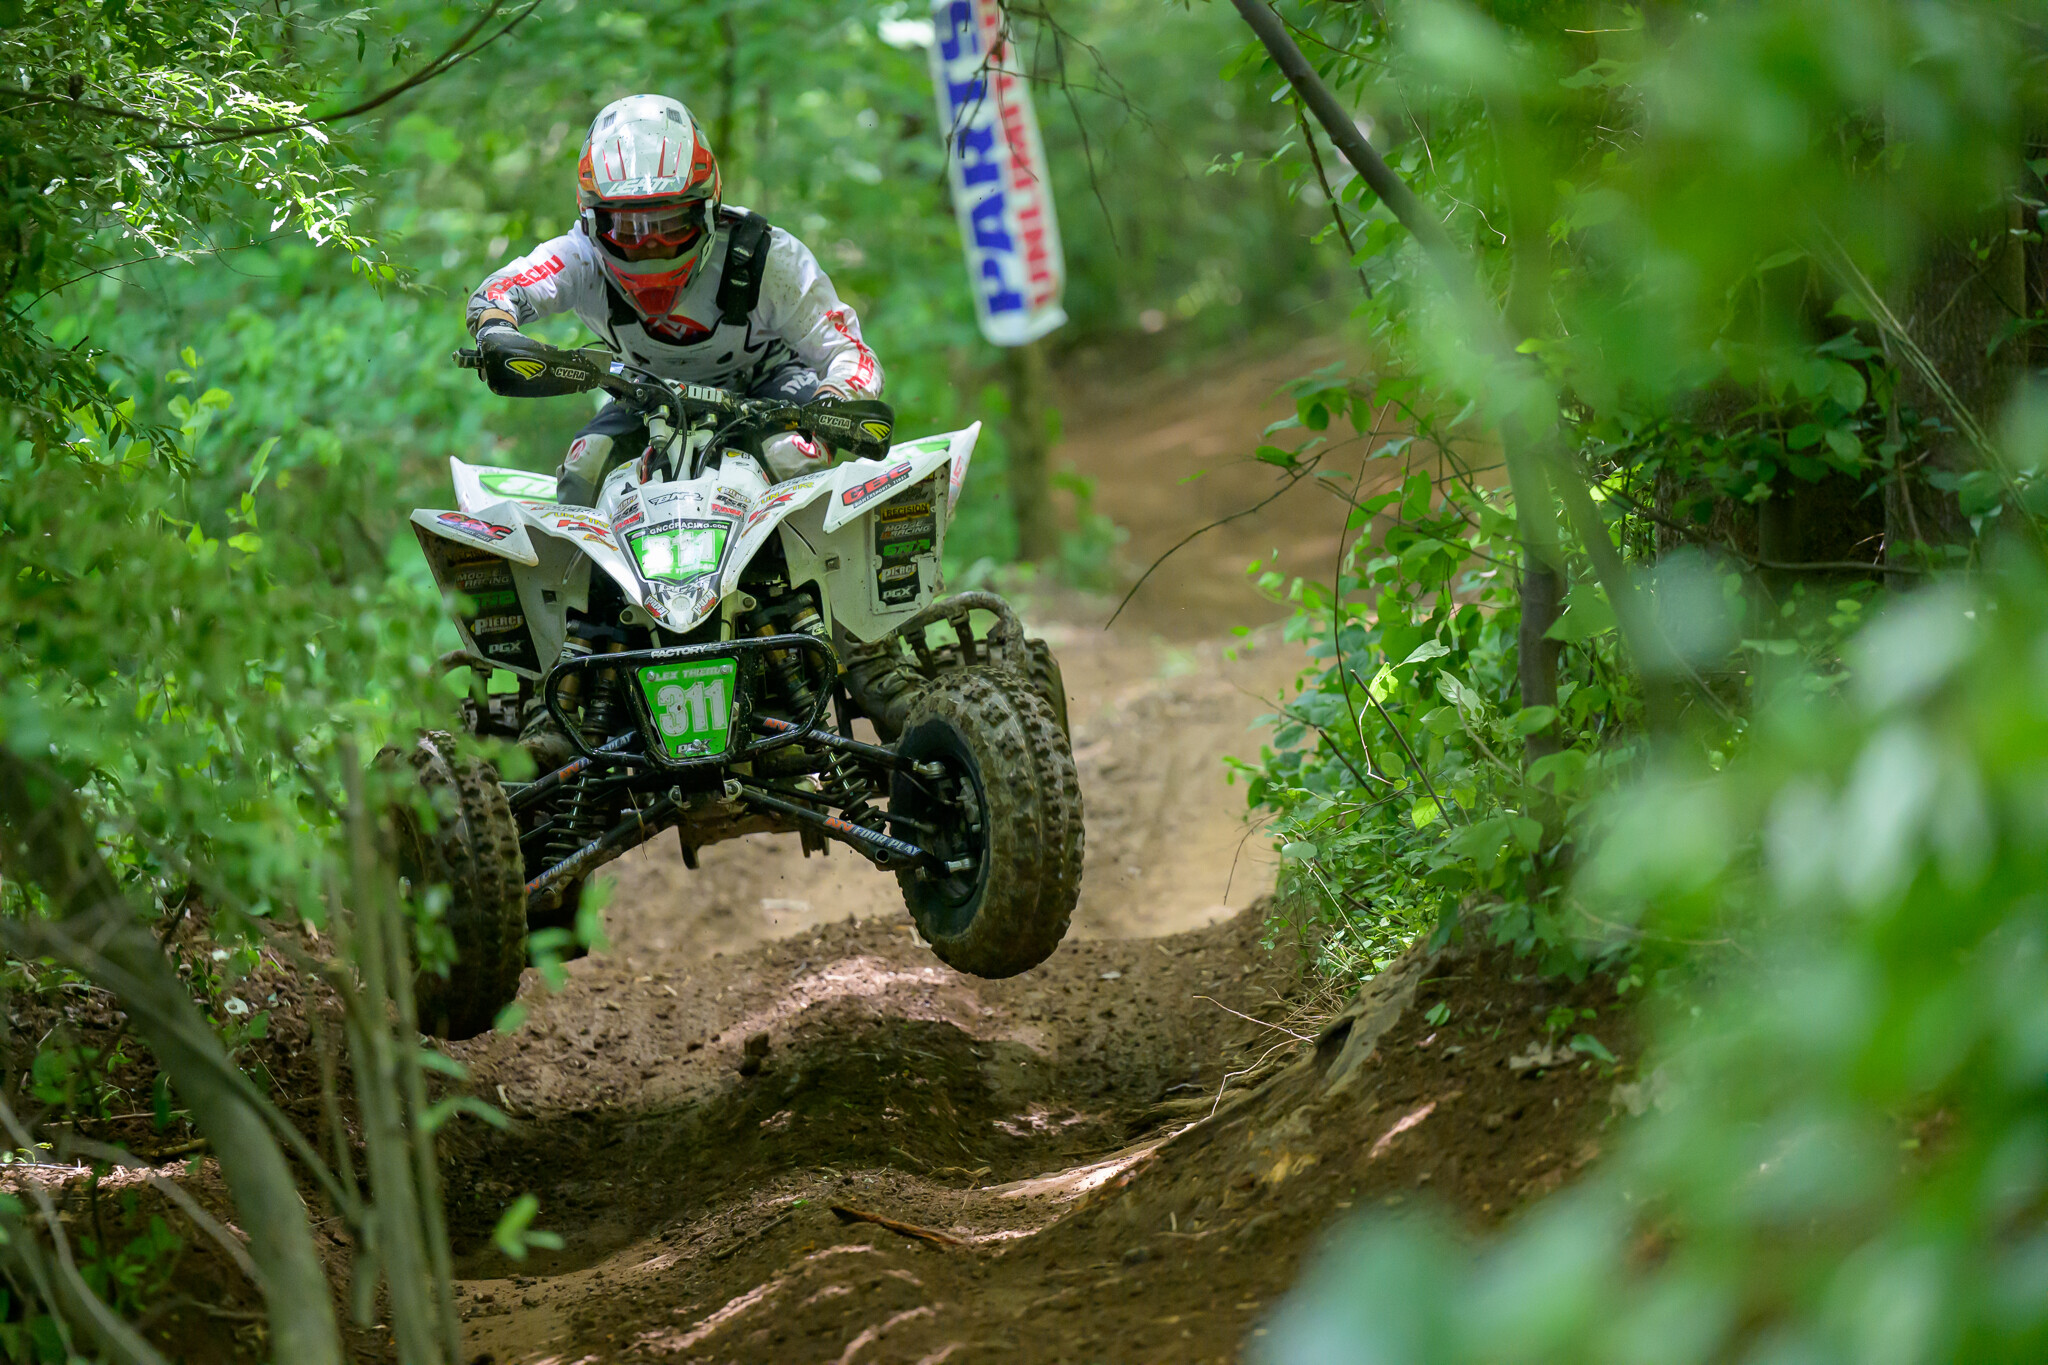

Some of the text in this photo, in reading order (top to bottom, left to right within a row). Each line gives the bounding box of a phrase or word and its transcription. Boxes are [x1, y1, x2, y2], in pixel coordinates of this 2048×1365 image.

[938, 0, 1022, 314] PARTS
[606, 177, 677, 196] LEATT
[555, 367, 586, 380] CYCRA
[820, 415, 850, 428] CYCRA
[841, 461, 912, 506] GBC
[641, 530, 716, 568] 311
[881, 564, 917, 582] PIERCE
[883, 585, 916, 599] PGX
[489, 641, 523, 654] PGX
[651, 645, 707, 659] FACTORY
[647, 670, 678, 683] LEX
[657, 679, 727, 736] 311
[853, 826, 887, 844] FOUR
[886, 837, 922, 856] PLAY
